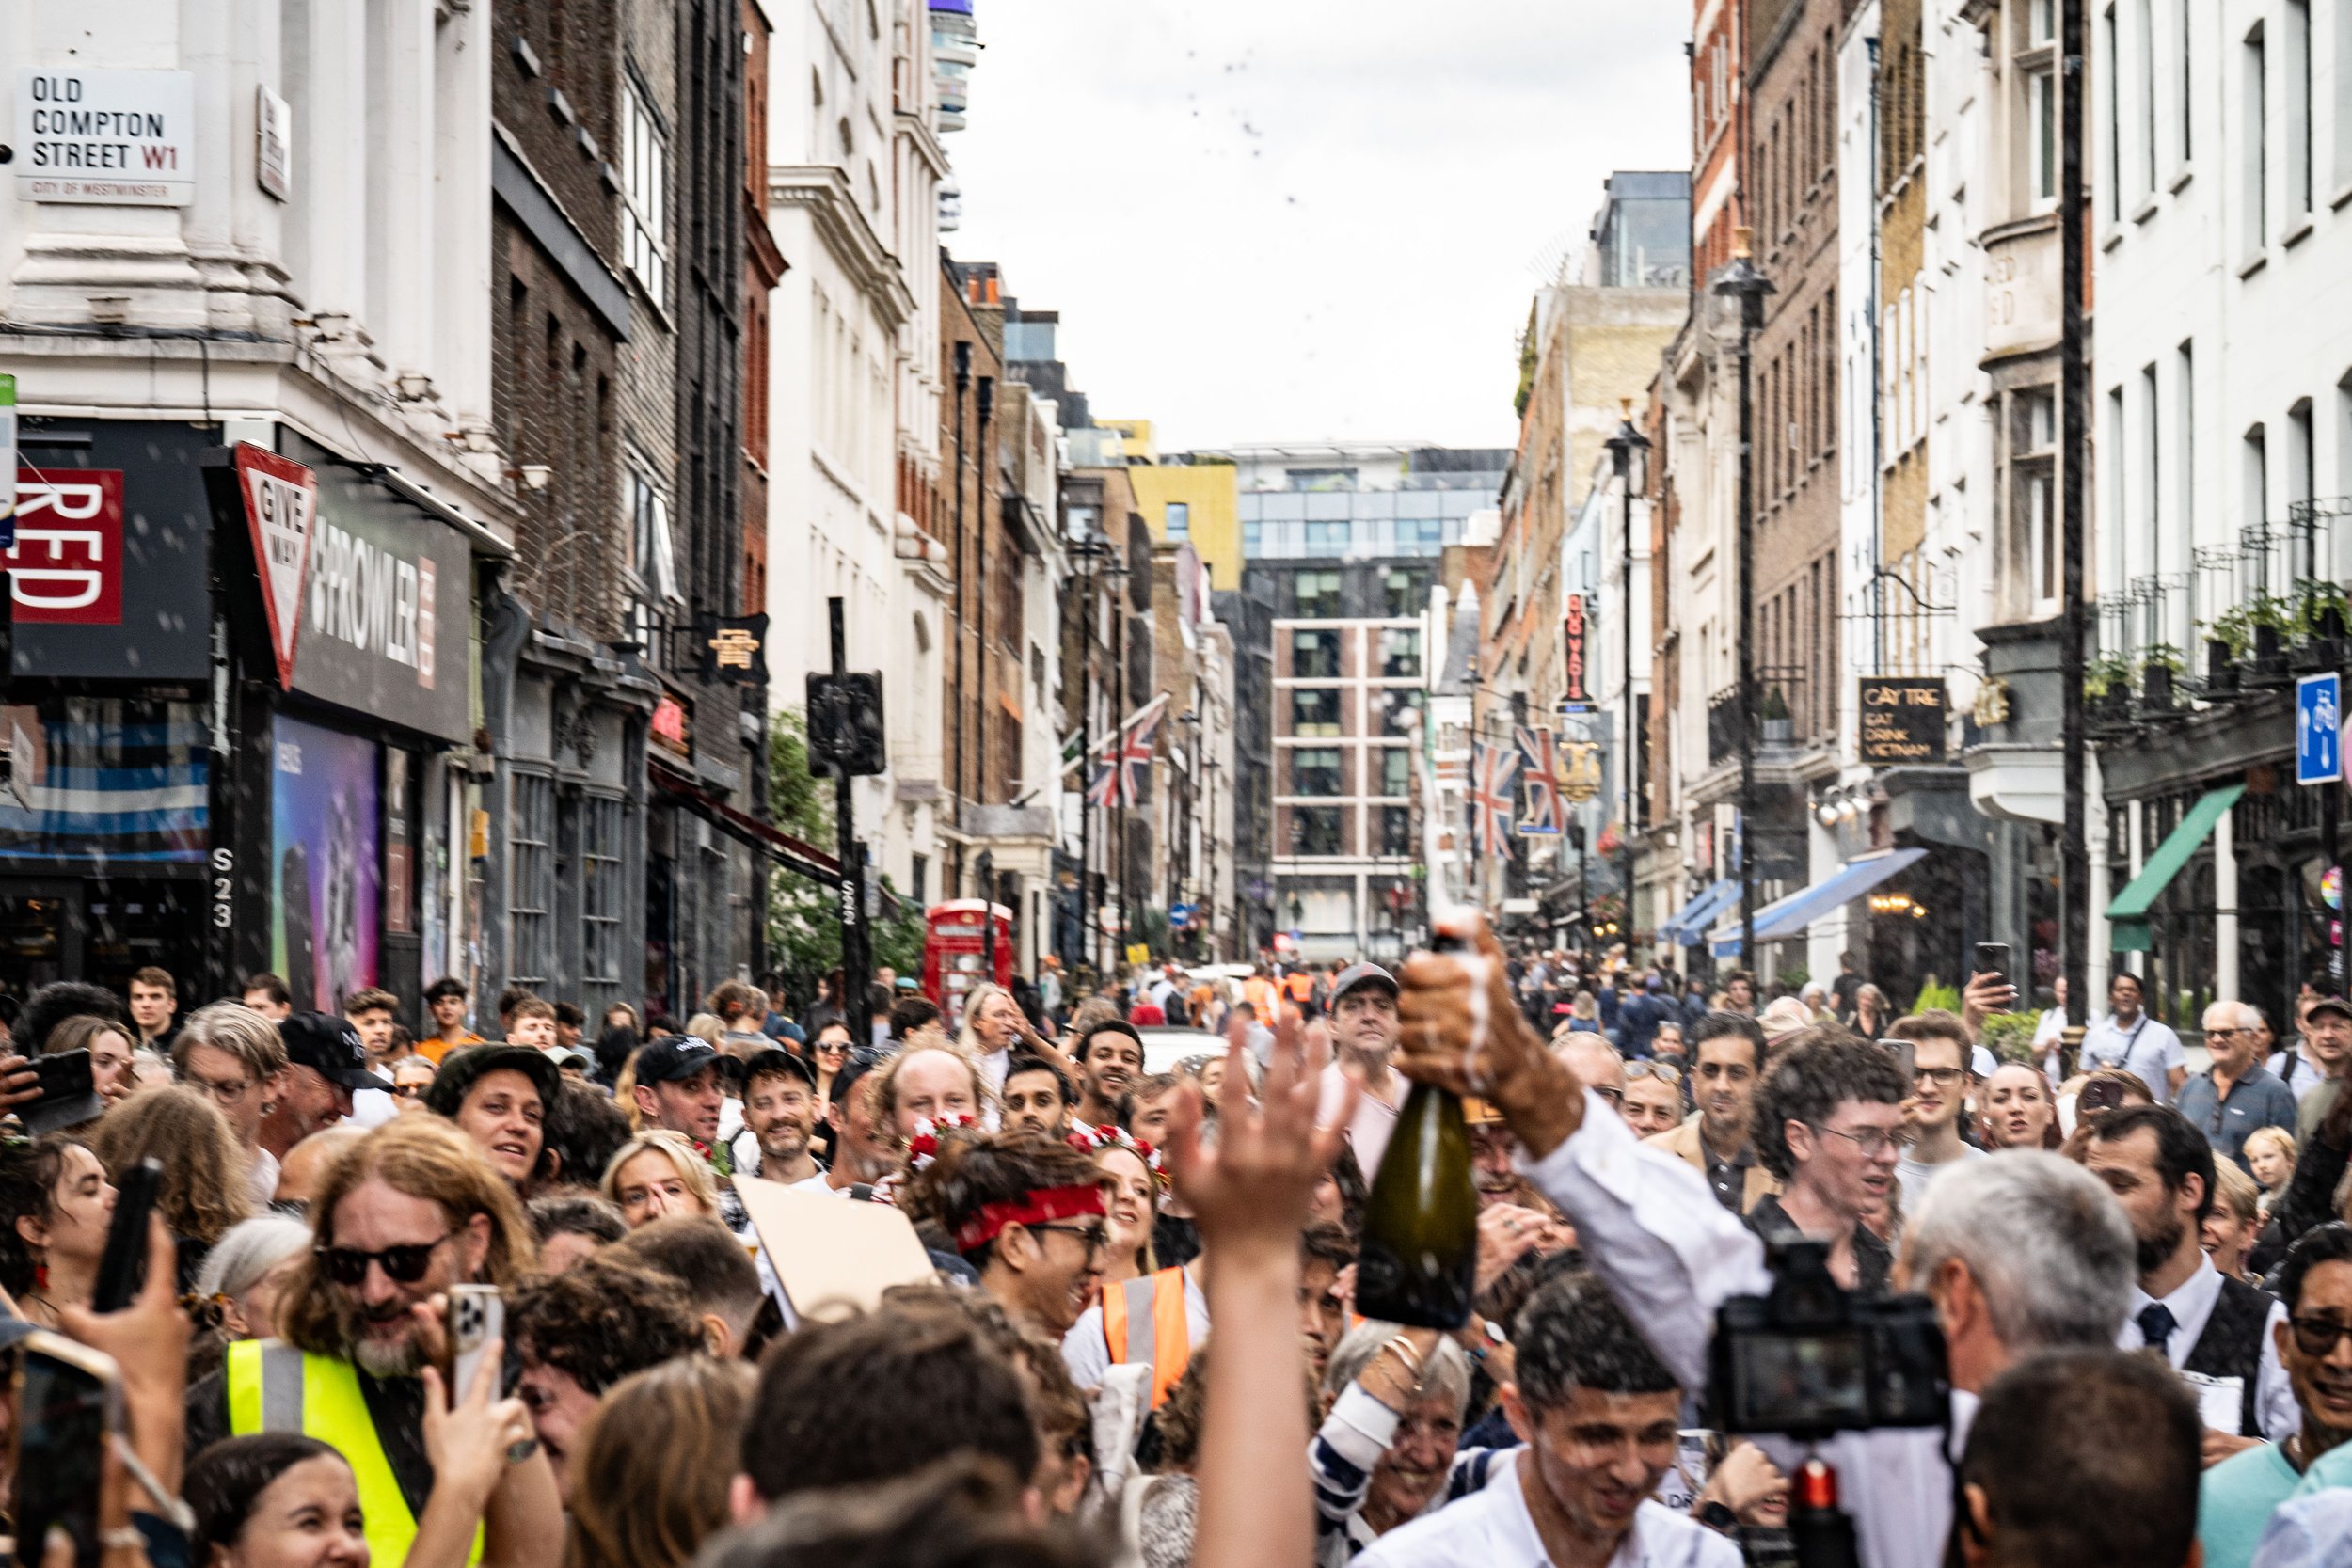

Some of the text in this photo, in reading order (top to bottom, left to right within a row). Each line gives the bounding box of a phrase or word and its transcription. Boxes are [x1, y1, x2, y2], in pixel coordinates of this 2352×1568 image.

[32, 76, 82, 103] OLD
[32, 109, 164, 138] COMPTON
[32, 141, 178, 170] STREET W1
[32, 182, 168, 197] CITY OF WESTMINSTER
[260, 478, 304, 536] GIVE
[7, 482, 103, 609] RED
[269, 532, 299, 570] WAY
[327, 523, 419, 670] PROWLER
[1865, 712, 1893, 726] EAT
[1864, 728, 1909, 741] DRINK
[1865, 743, 1931, 757] VIETNAM
